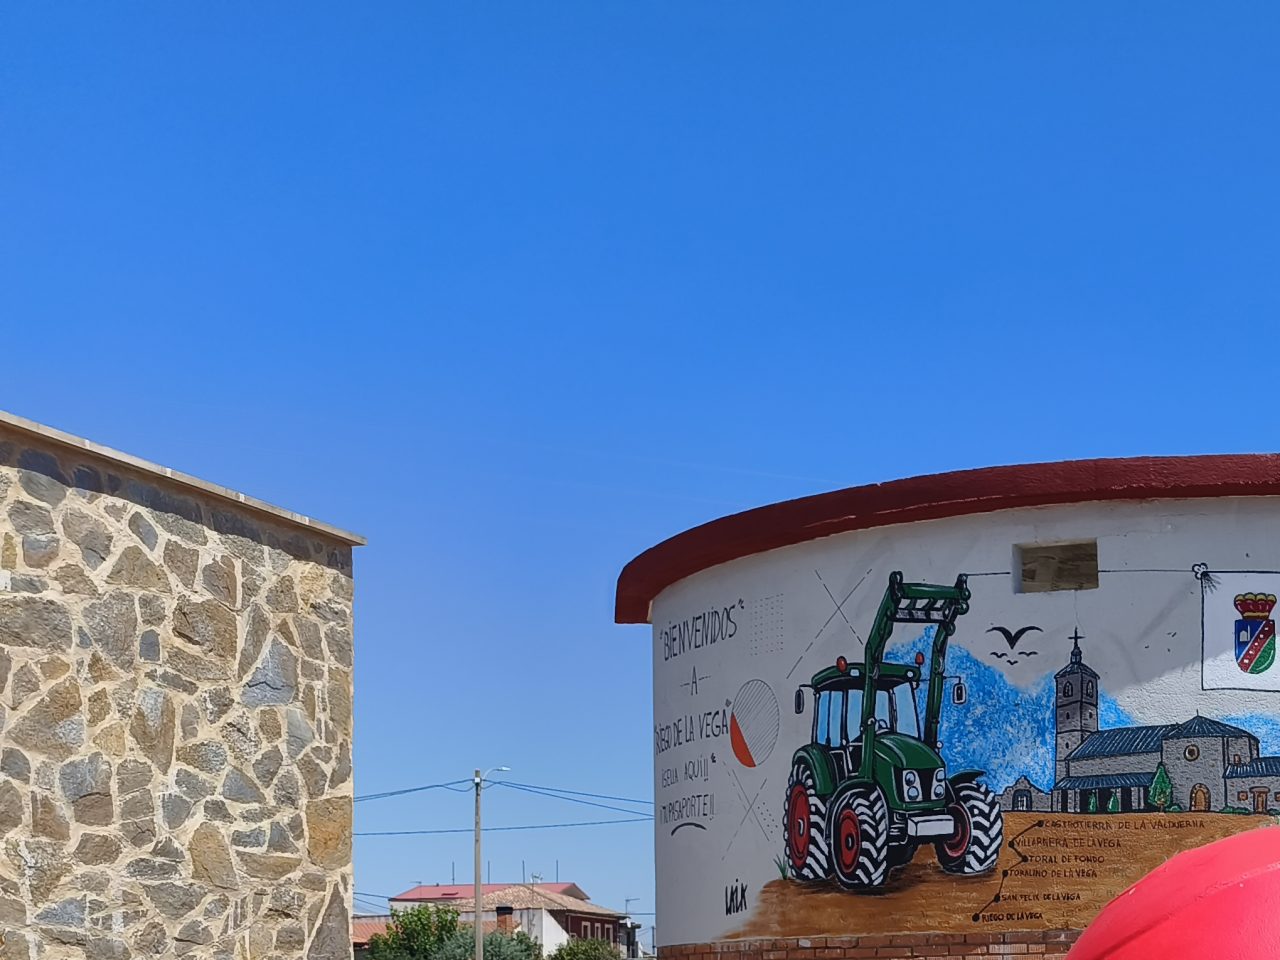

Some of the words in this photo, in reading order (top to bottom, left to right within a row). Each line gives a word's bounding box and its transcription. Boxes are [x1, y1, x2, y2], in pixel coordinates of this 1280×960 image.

[673, 718, 683, 747] DE
[684, 715, 695, 743] LA
[1118, 821, 1130, 830] DE
[1134, 819, 1147, 830] LA
[1097, 839, 1122, 848] VEGA
[1028, 854, 1057, 864] TORAL
[1061, 854, 1073, 864] DE
[1074, 855, 1105, 864] FONDO
[1051, 869, 1062, 878] DE
[1063, 868, 1074, 878] LA
[1074, 868, 1098, 878] VEGA
